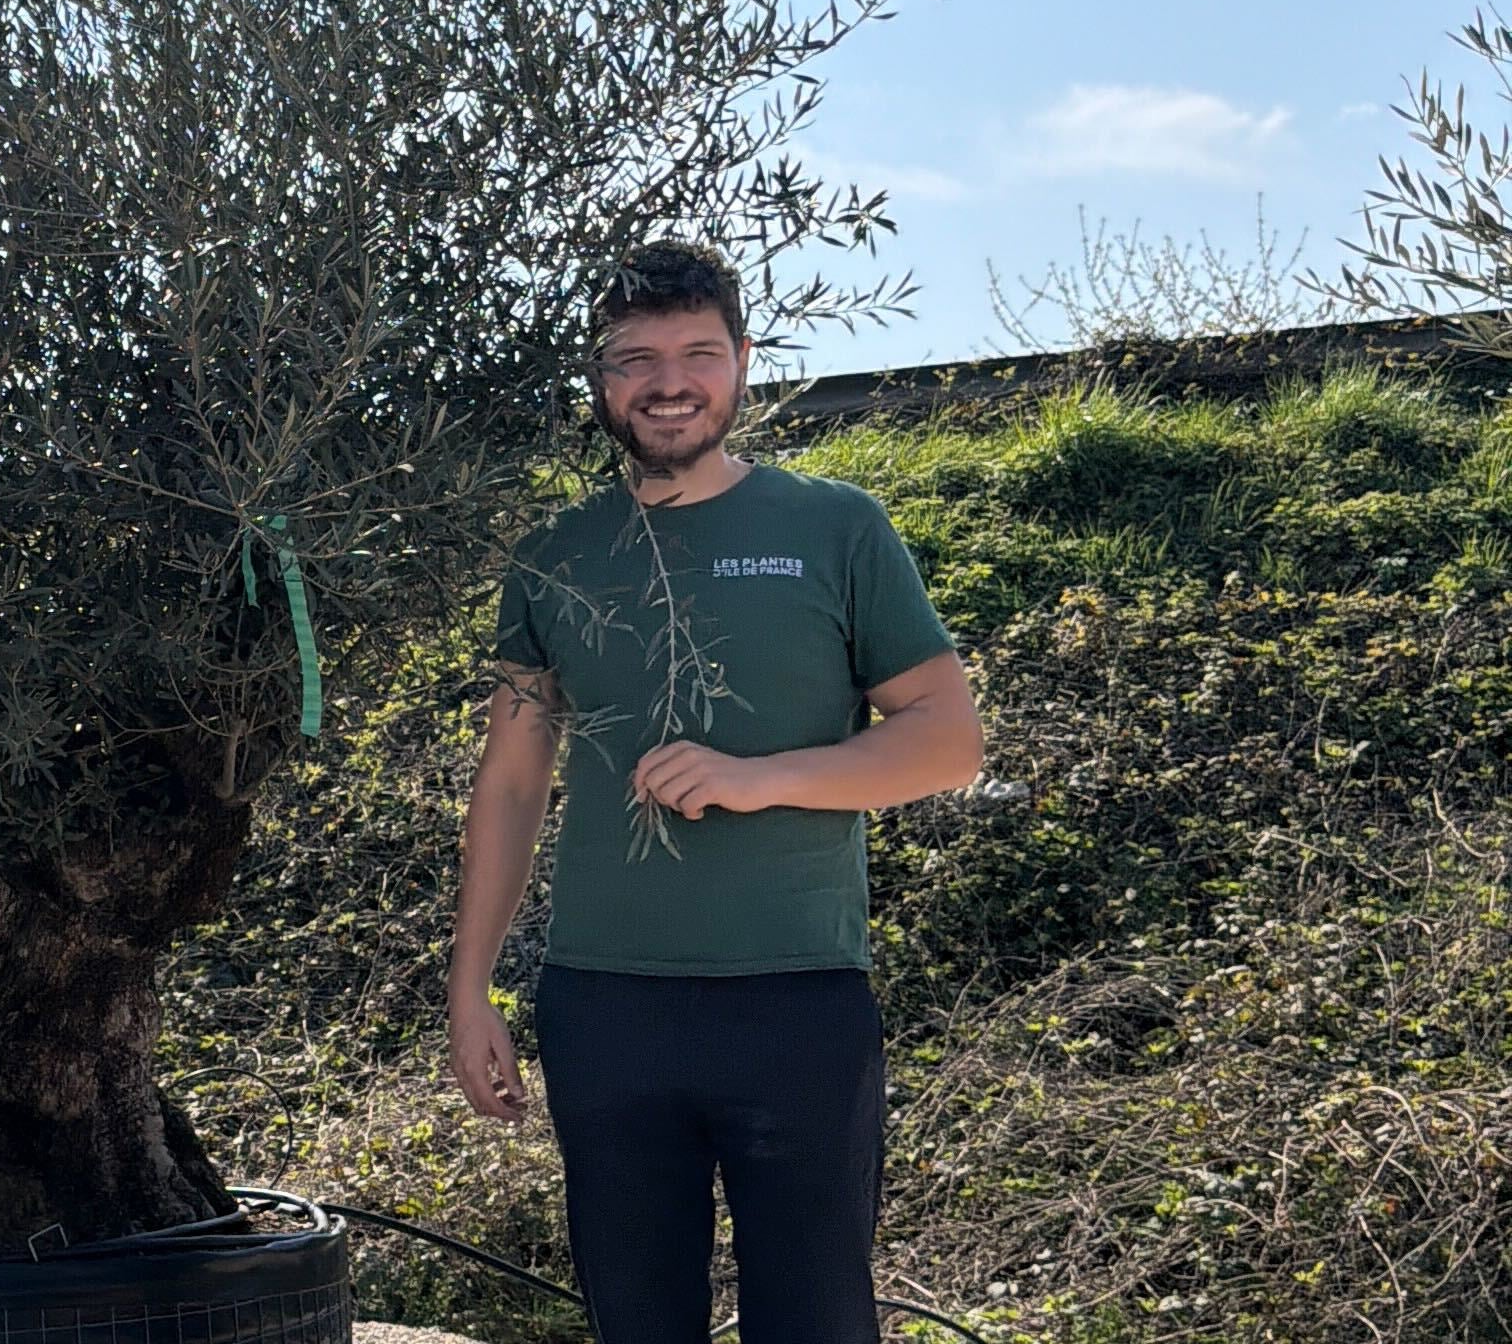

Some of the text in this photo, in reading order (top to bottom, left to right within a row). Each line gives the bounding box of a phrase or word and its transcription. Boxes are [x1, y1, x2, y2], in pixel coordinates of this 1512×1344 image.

[713, 556, 803, 569] LES PLANTES
[742, 567, 757, 576] DE
[759, 566, 803, 578] FRANCE
